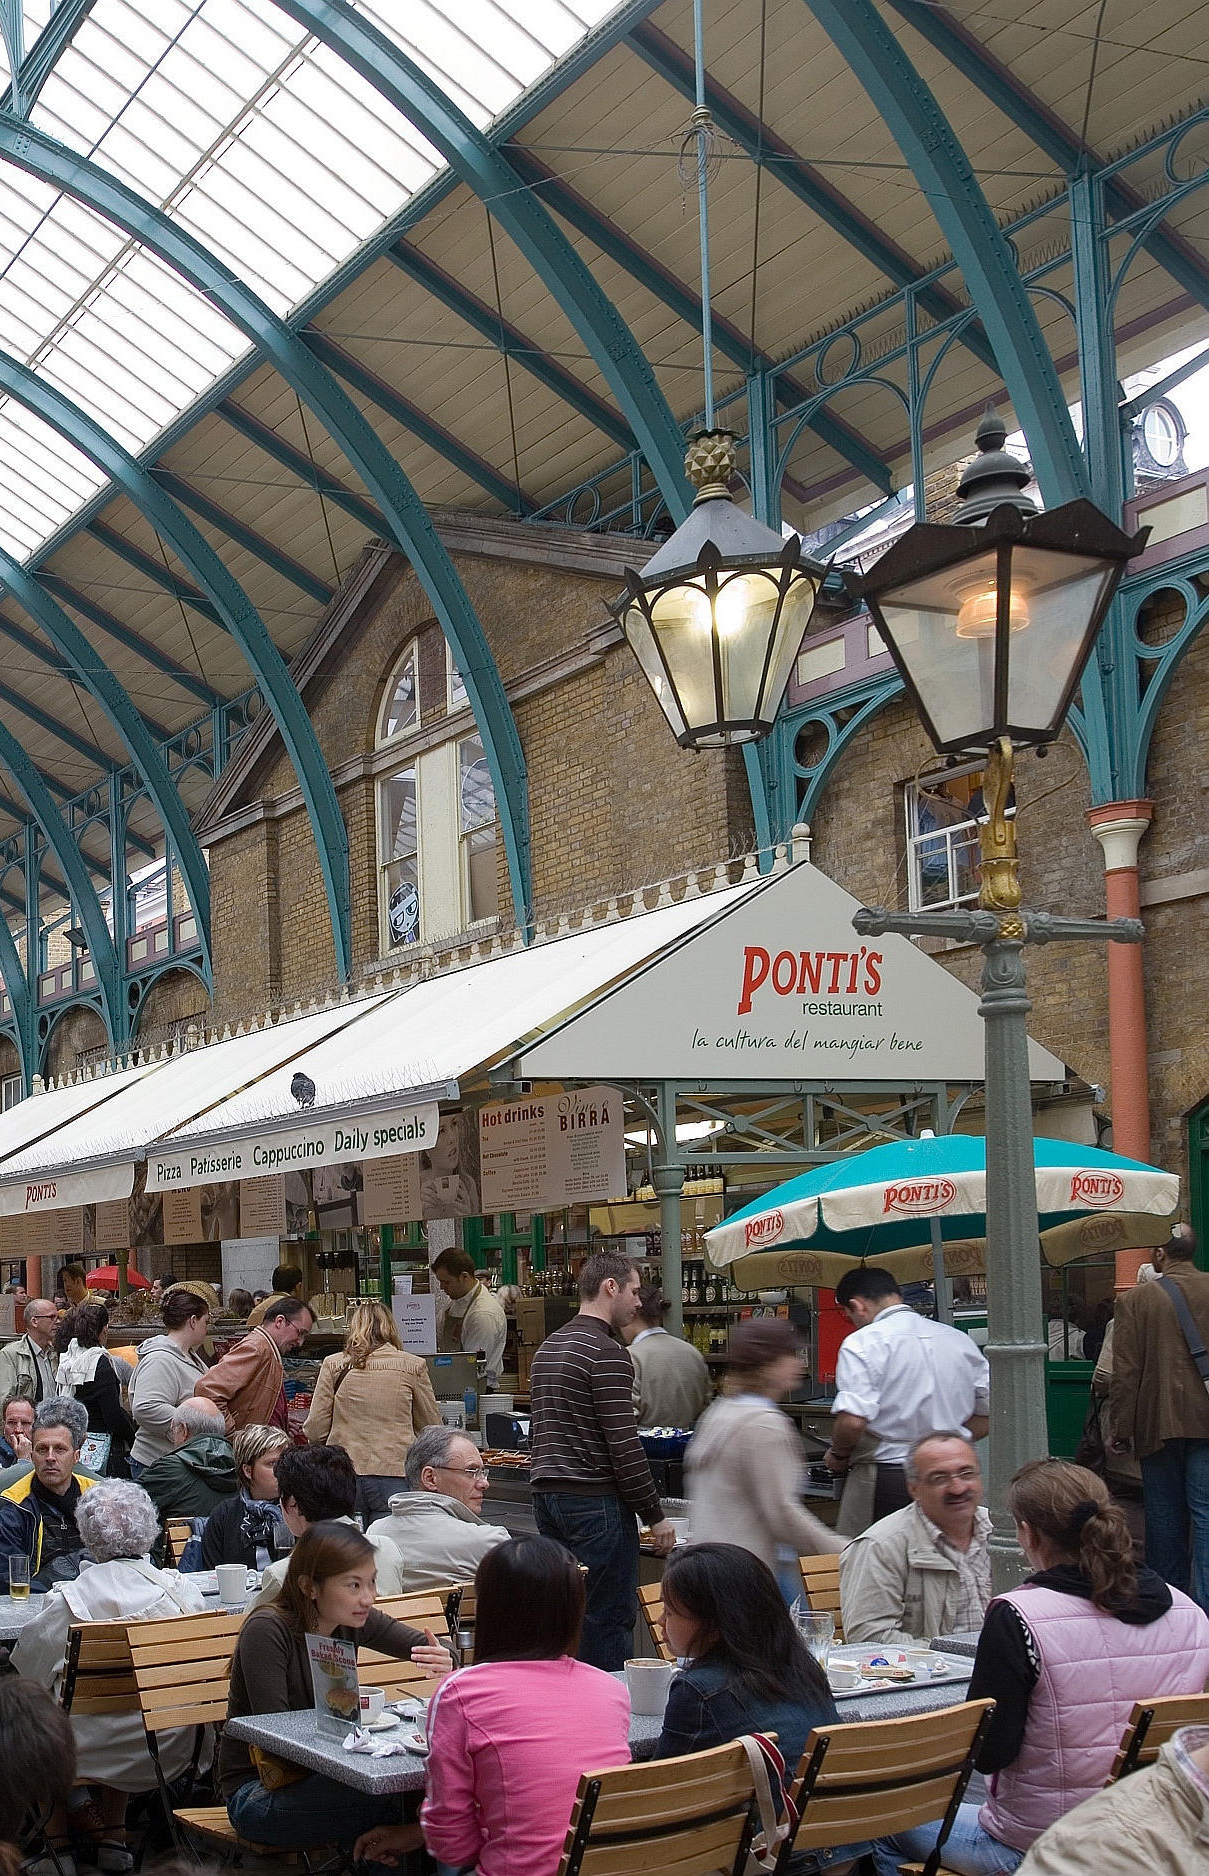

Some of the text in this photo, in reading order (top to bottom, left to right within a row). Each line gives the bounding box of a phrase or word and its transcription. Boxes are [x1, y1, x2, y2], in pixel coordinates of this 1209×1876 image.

[737, 946, 883, 1016] PONTI'S
[802, 1001, 883, 1017] restaurant
[692, 1028, 924, 1060] la cultura del mangiar bene
[482, 1104, 545, 1127] Hot drinks
[559, 1108, 610, 1131] BIRRA
[157, 1115, 426, 1182] Pizza Patisserie Cappuccino Daily specials
[25, 1182, 58, 1210] PONTI'S
[882, 1182, 953, 1214] PONTI'S
[1069, 1176, 1122, 1203] PONTI'S
[745, 1213, 782, 1249] PONTI'S
[311, 1649, 332, 1661] Baked
[319, 1641, 344, 1656] Freshly
